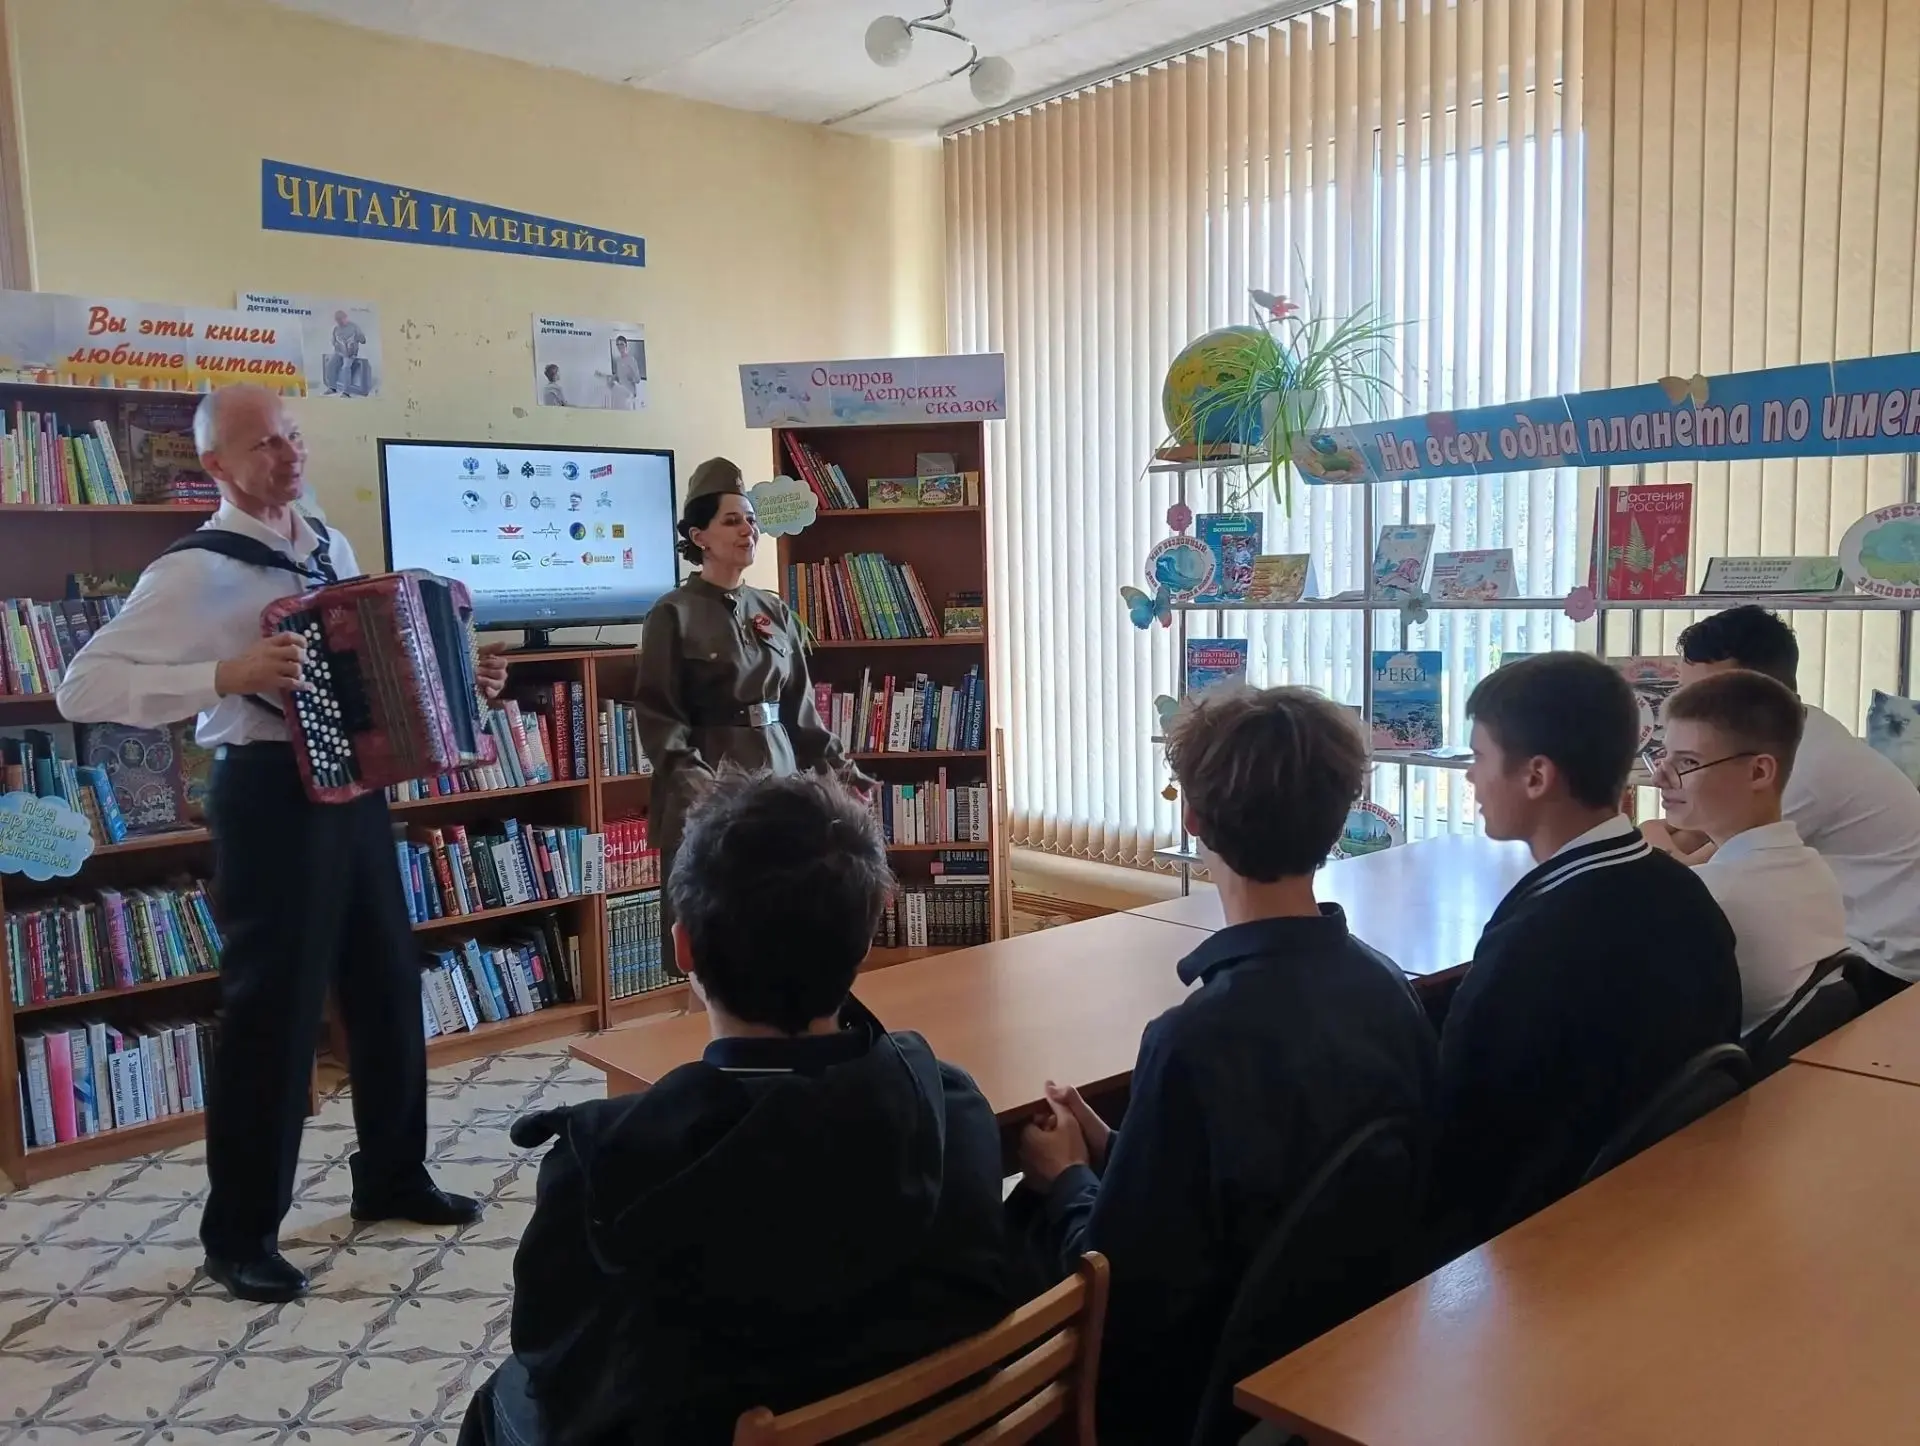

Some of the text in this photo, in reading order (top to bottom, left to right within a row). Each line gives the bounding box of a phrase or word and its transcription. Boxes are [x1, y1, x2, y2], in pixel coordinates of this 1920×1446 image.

[275, 172, 640, 259] ЧИТАЙ И МЕНЯЙСЯ
[246, 294, 290, 306] Читайте
[246, 304, 312, 316] детям книги
[88, 306, 276, 345] Вы эти книги
[540, 318, 574, 328] Читайте
[67, 342, 297, 376] любите читать
[811, 367, 893, 391] Остров
[863, 385, 957, 406] детских
[925, 397, 999, 415] сказок
[1375, 432, 1421, 472] На
[1425, 426, 1494, 468] всех
[1500, 413, 1580, 461] одна
[1587, 403, 1751, 454] планета
[1761, 397, 1811, 443] по
[1618, 490, 1684, 502] Растения
[1377, 667, 1427, 681] РЕКИ
[971, 700, 982, 747] МИФОЛОГИЯ
[0, 812, 78, 841] арусами
